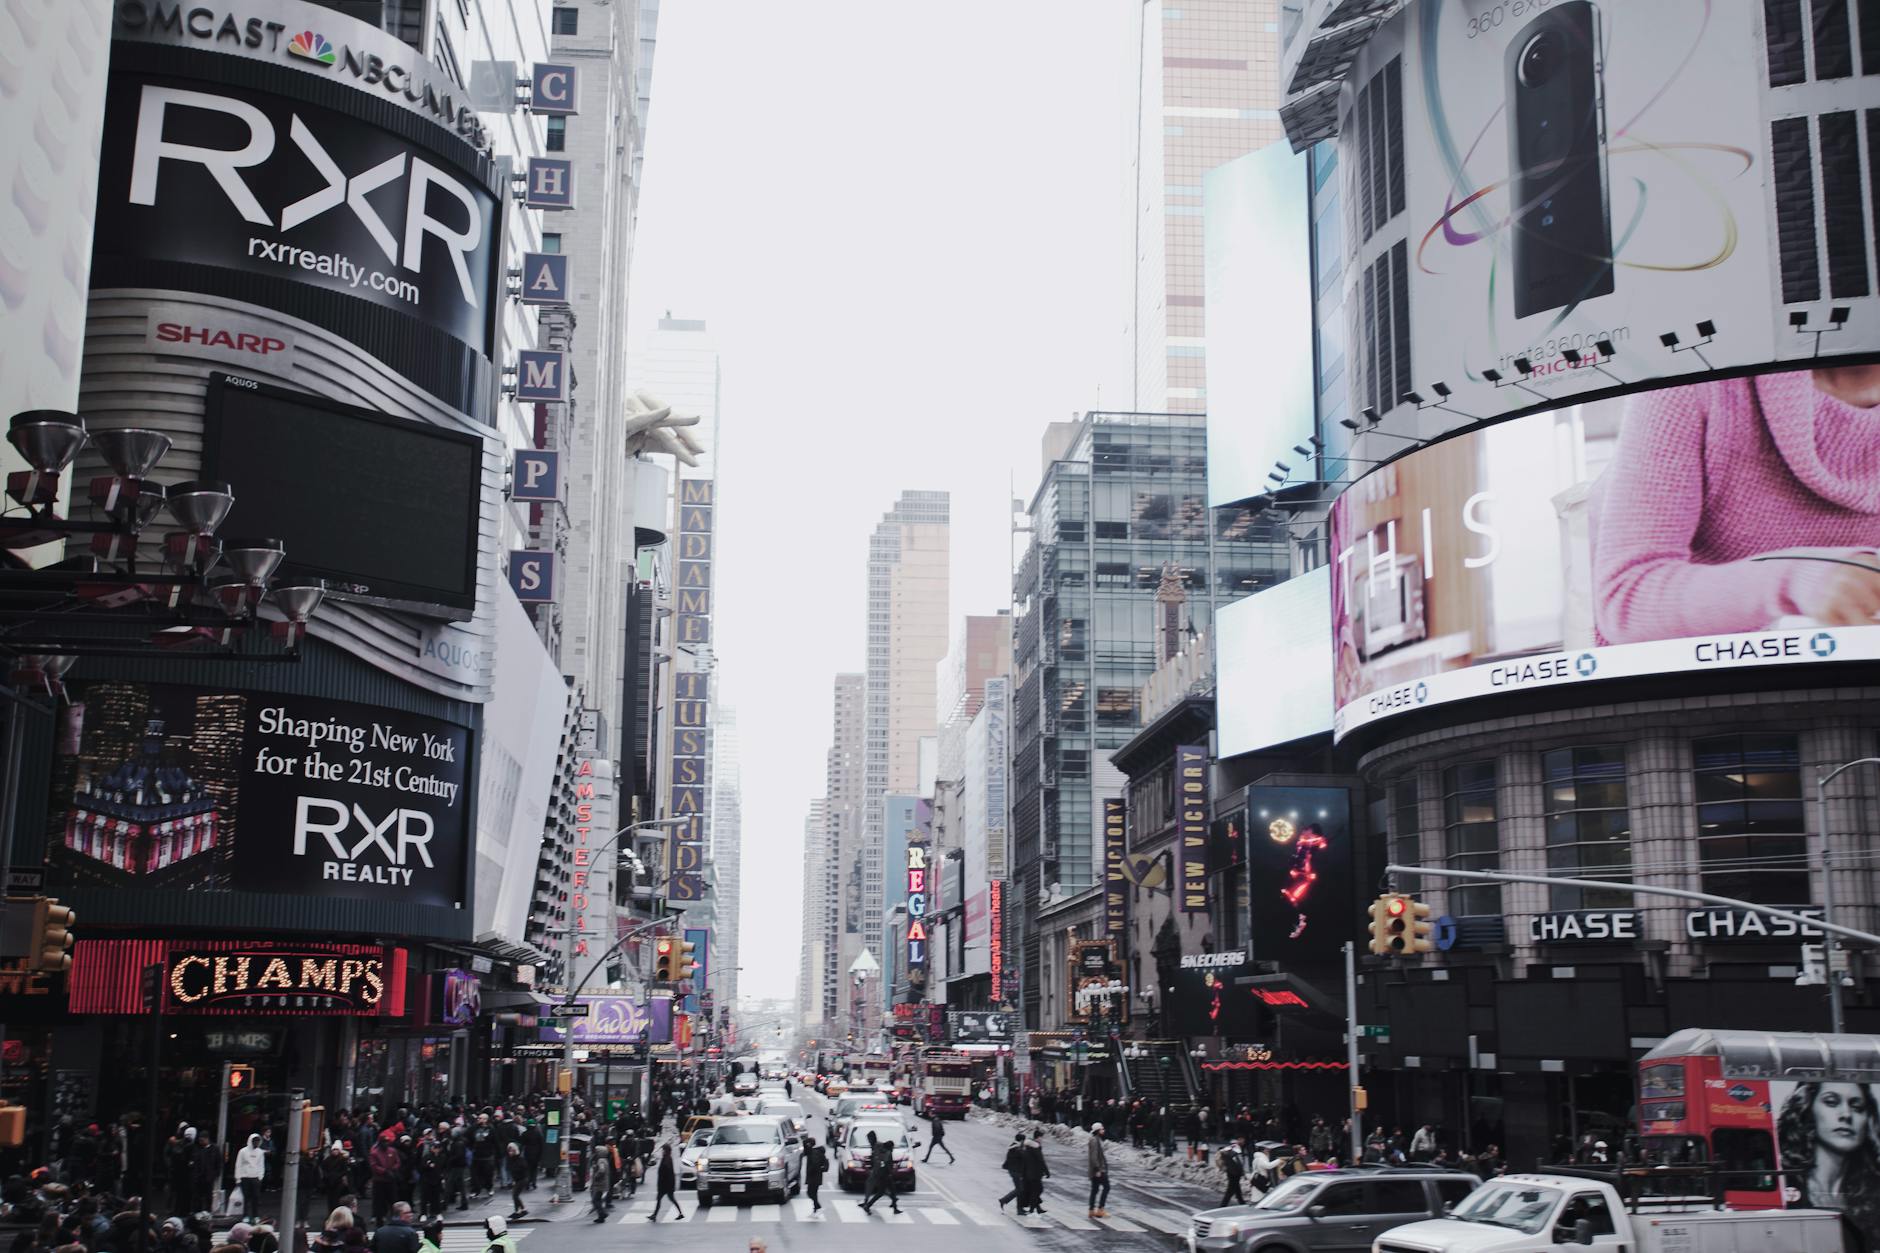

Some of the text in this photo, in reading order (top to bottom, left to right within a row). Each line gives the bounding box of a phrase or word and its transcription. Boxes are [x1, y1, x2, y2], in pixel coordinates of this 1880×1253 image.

[129, 85, 482, 308] RXR
[248, 237, 420, 305] rxrrealty.com
[156, 323, 286, 355] SHARP
[225, 376, 258, 389] AQUOS
[1338, 491, 1500, 616] THIS
[424, 638, 479, 672] AQUOS
[1696, 636, 1800, 662] CHASE
[1490, 658, 1568, 686] CHASE
[675, 483, 711, 898] MADAME TUSSAUDS
[1369, 688, 1410, 714] CHASE
[258, 707, 455, 763] Shaping New York
[254, 747, 459, 807] for the 21st Century
[293, 796, 434, 868] RXR
[1183, 752, 1205, 908] NEW VICTORY
[13, 873, 36, 884] WAY
[323, 861, 413, 886] REALTY
[1106, 802, 1124, 930] NEW VICTORY
[907, 847, 926, 963] REGAL
[1529, 913, 1637, 941] CHASE
[1687, 909, 1824, 937] CHASE
[1180, 952, 1246, 968] SKECHERS
[170, 954, 383, 1004] CHAMPS
[244, 996, 333, 1008] SPORTS
[513, 1048, 554, 1058] SEPHORA
